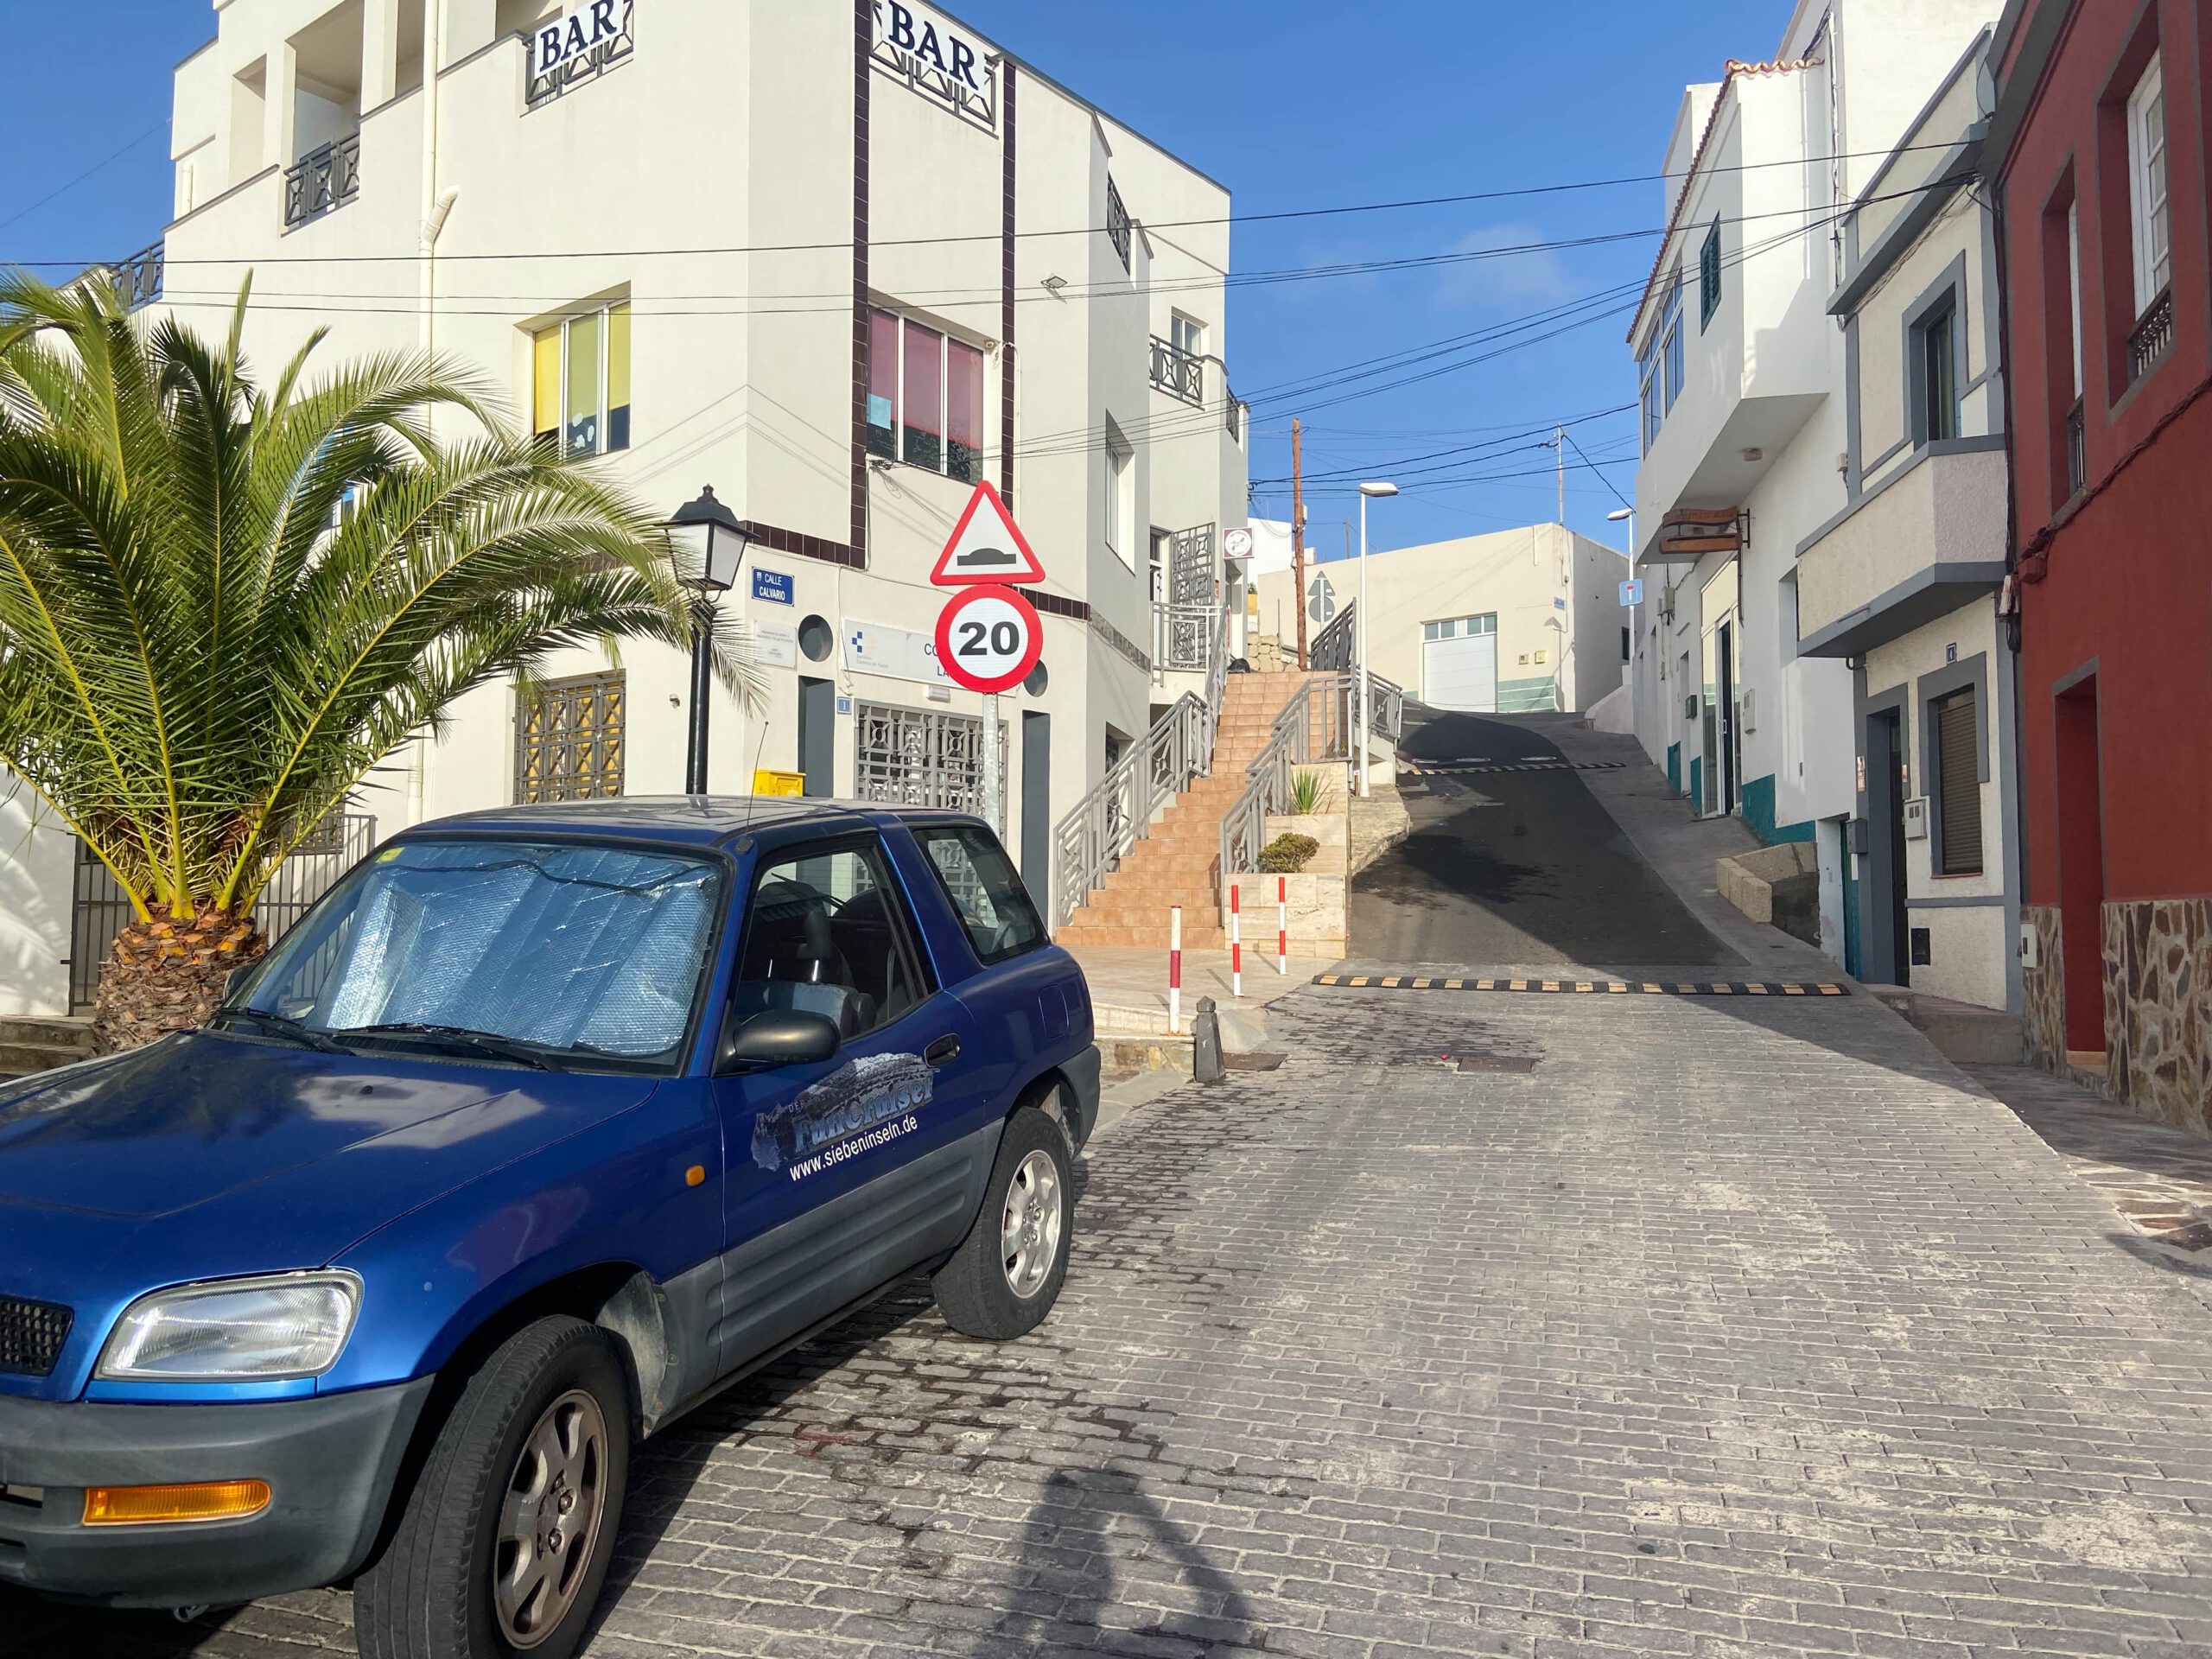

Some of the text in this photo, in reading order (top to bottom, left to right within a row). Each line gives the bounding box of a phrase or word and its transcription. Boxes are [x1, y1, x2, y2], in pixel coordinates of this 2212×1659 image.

[539, 0, 618, 73] BAR
[888, 0, 979, 91] BAR
[759, 586, 785, 601] CALVARIO
[764, 573, 783, 587] CALLE
[958, 620, 1020, 656] 20
[789, 1114, 918, 1182] www.siebeninseln.de
